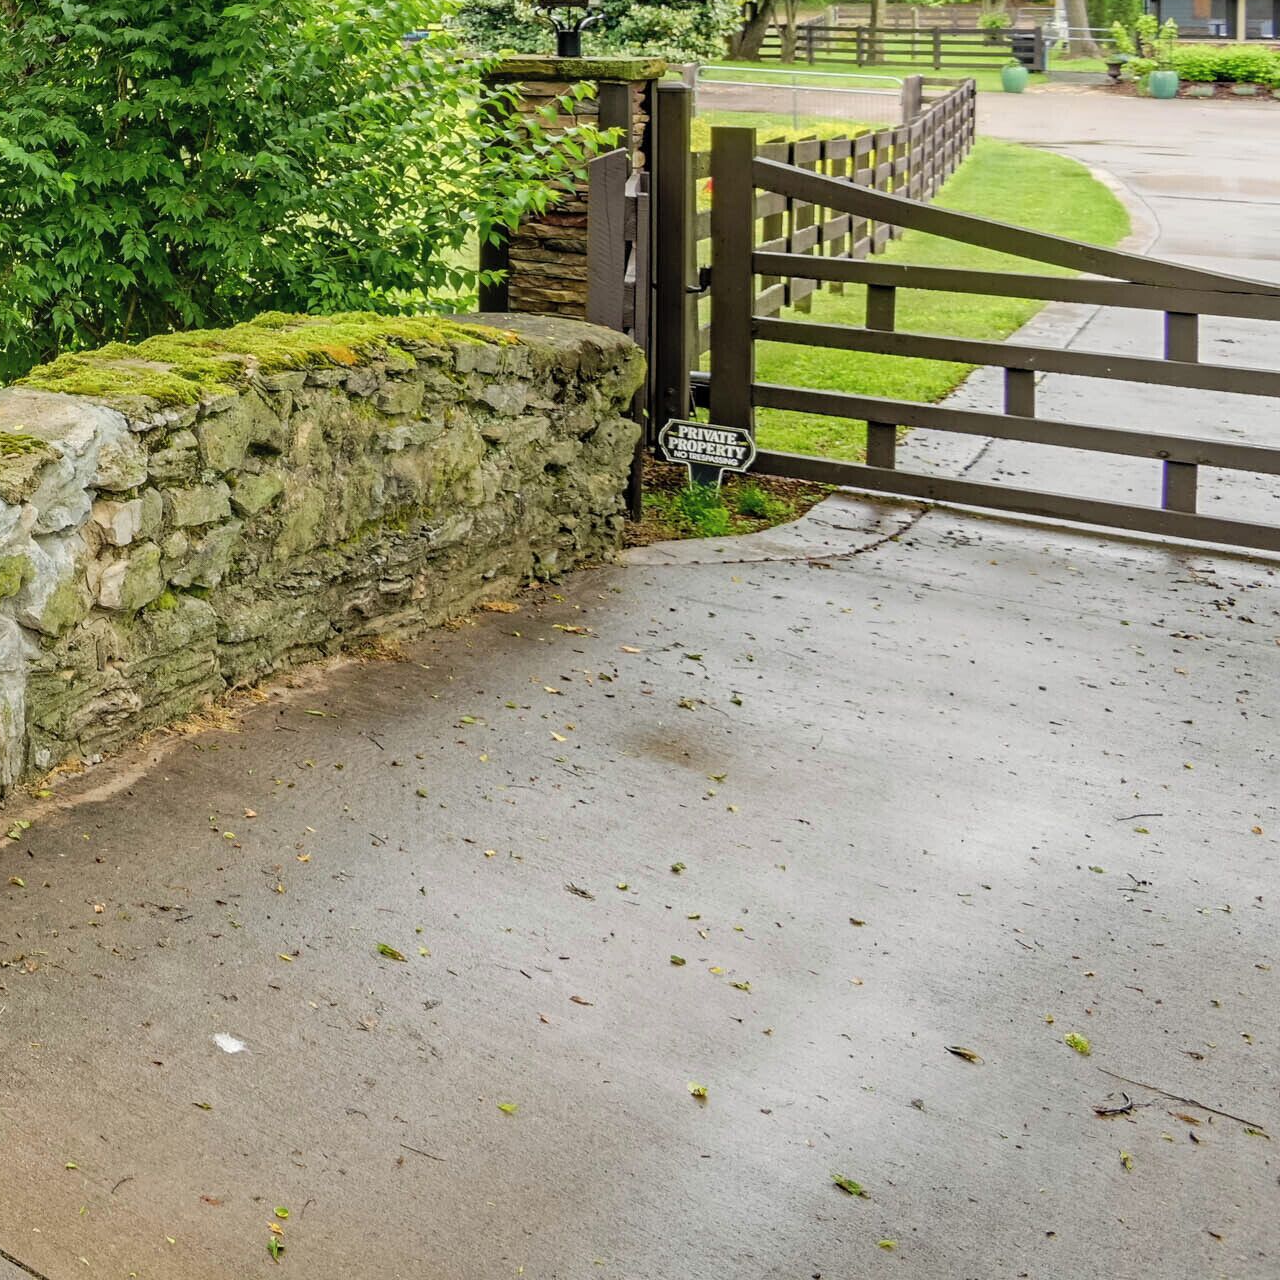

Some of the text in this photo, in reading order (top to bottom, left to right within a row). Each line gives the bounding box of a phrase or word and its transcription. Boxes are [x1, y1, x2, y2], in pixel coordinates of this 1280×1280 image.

[678, 425, 738, 446] PRIVATE
[668, 437, 747, 459] PROPERTY
[673, 450, 739, 466] NO TRESPASSING
